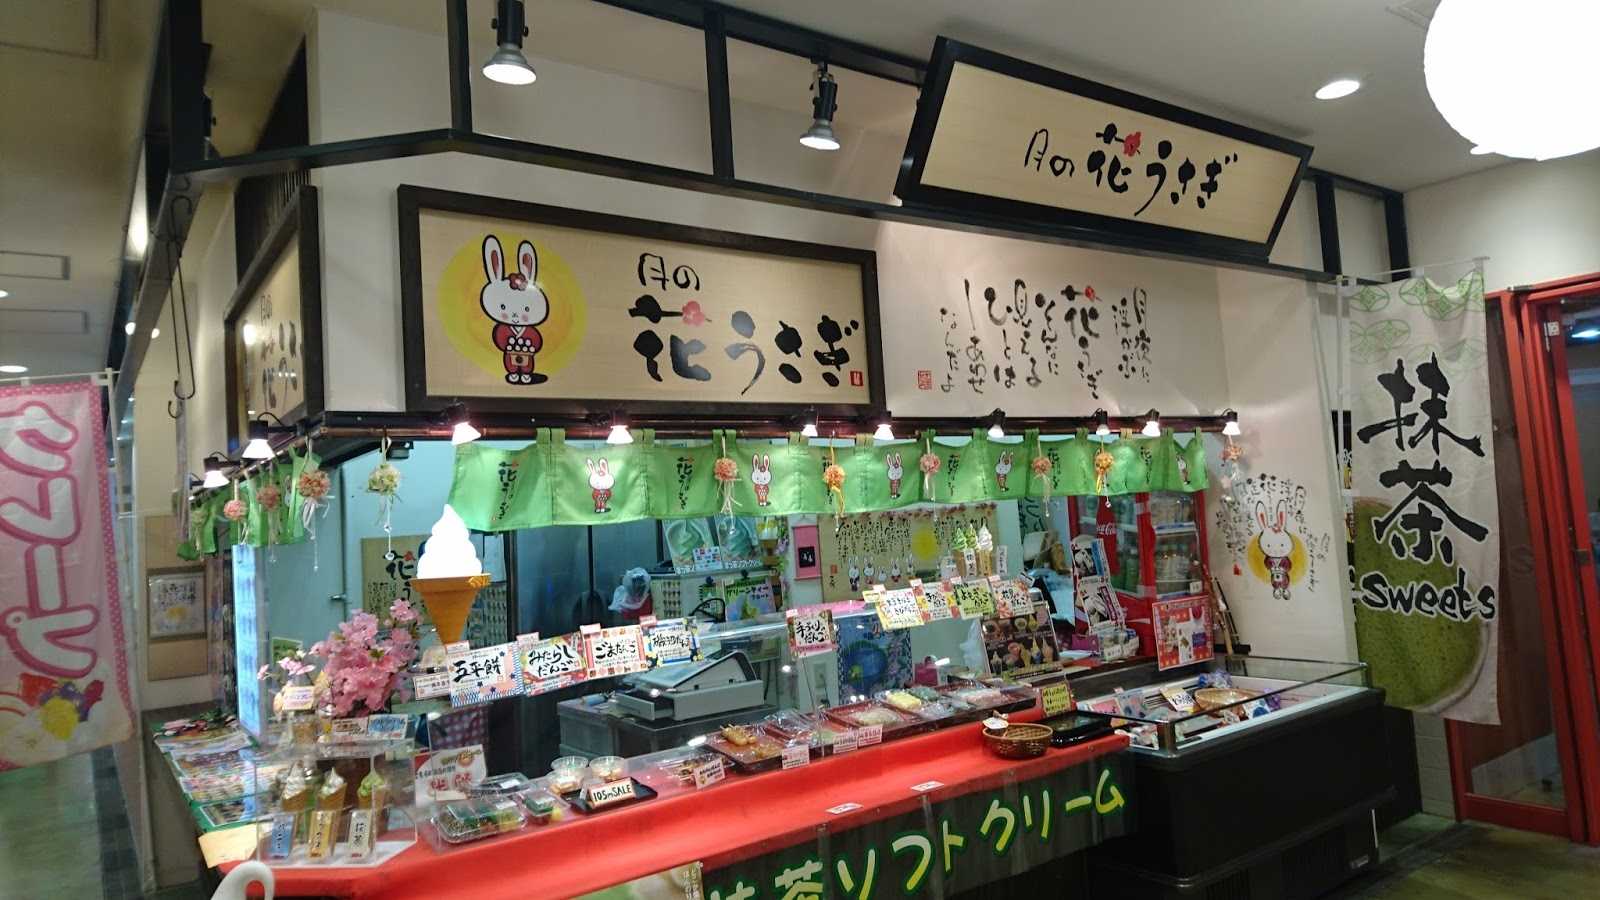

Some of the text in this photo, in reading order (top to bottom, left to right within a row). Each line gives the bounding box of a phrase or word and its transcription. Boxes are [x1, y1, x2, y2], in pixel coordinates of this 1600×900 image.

[1024, 122, 1238, 216] 月の花うさぎ
[638, 252, 700, 291] 月の
[628, 294, 859, 396] 花うさぎ
[1356, 352, 1488, 566] 抹茶
[452, 655, 501, 682] 五平餅
[529, 644, 575, 665] みたらし
[537, 660, 574, 678] だんご
[709, 768, 1126, 900] 茶ソフトクリーム
